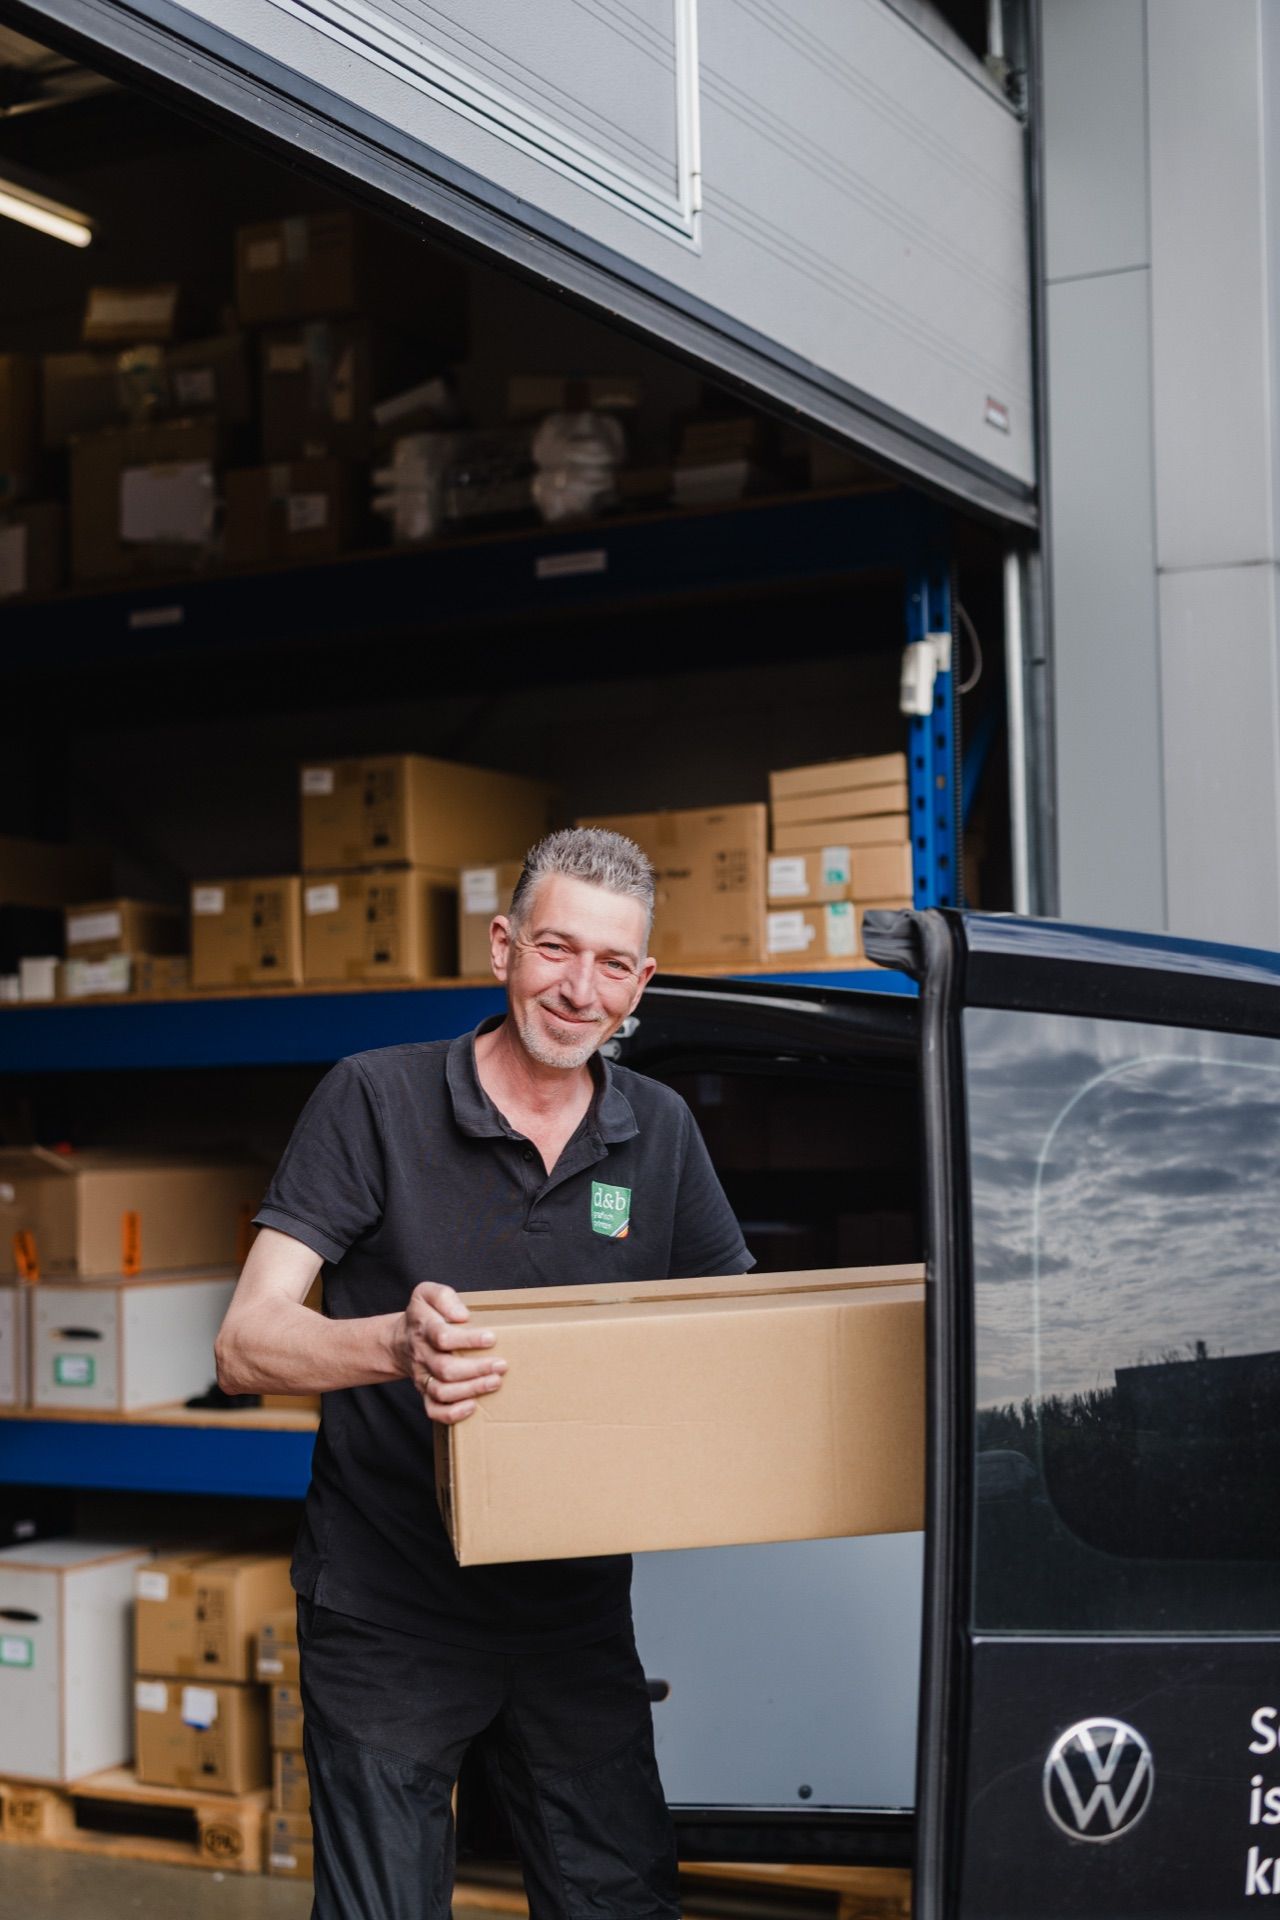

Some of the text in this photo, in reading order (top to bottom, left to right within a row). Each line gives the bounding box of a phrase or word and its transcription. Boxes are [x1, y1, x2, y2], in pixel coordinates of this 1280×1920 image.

[593, 1187, 626, 1211] d&b
[1249, 1706, 1280, 1755] S
[1048, 1721, 1152, 1837] VW
